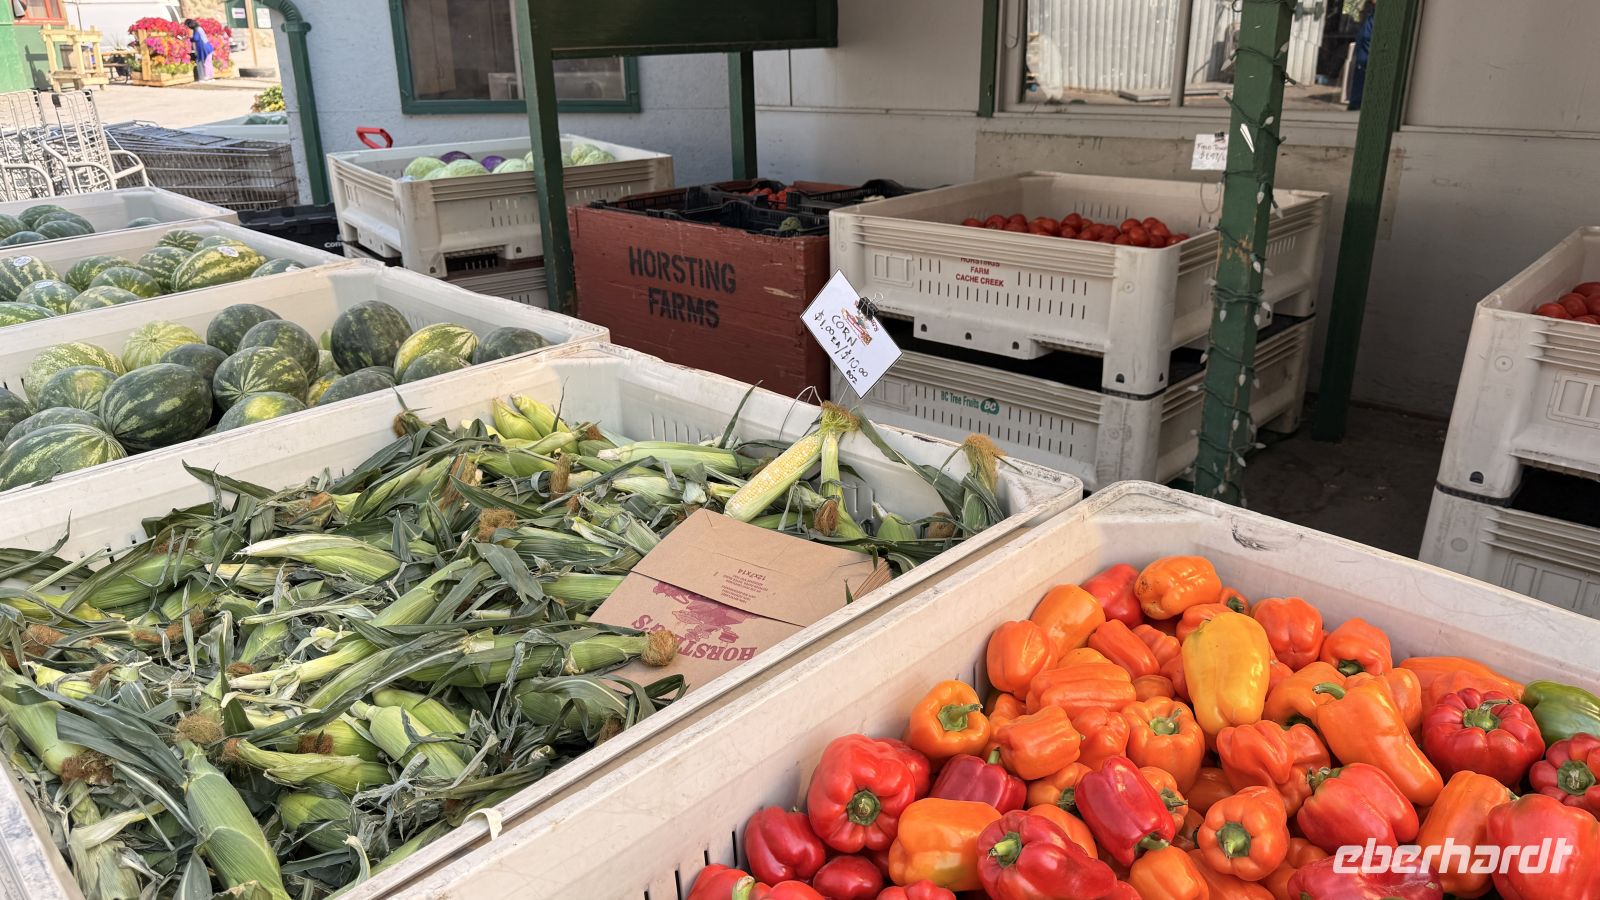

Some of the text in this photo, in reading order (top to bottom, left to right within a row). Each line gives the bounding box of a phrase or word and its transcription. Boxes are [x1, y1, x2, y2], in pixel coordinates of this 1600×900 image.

[628, 245, 737, 294] HORSTING
[970, 266, 990, 275] FARM
[955, 273, 1005, 287] CACHE CREEK
[648, 286, 720, 329] FARMS
[831, 314, 858, 347] CORN
[941, 390, 979, 409] BC Tree Fruits
[983, 400, 997, 412] BC
